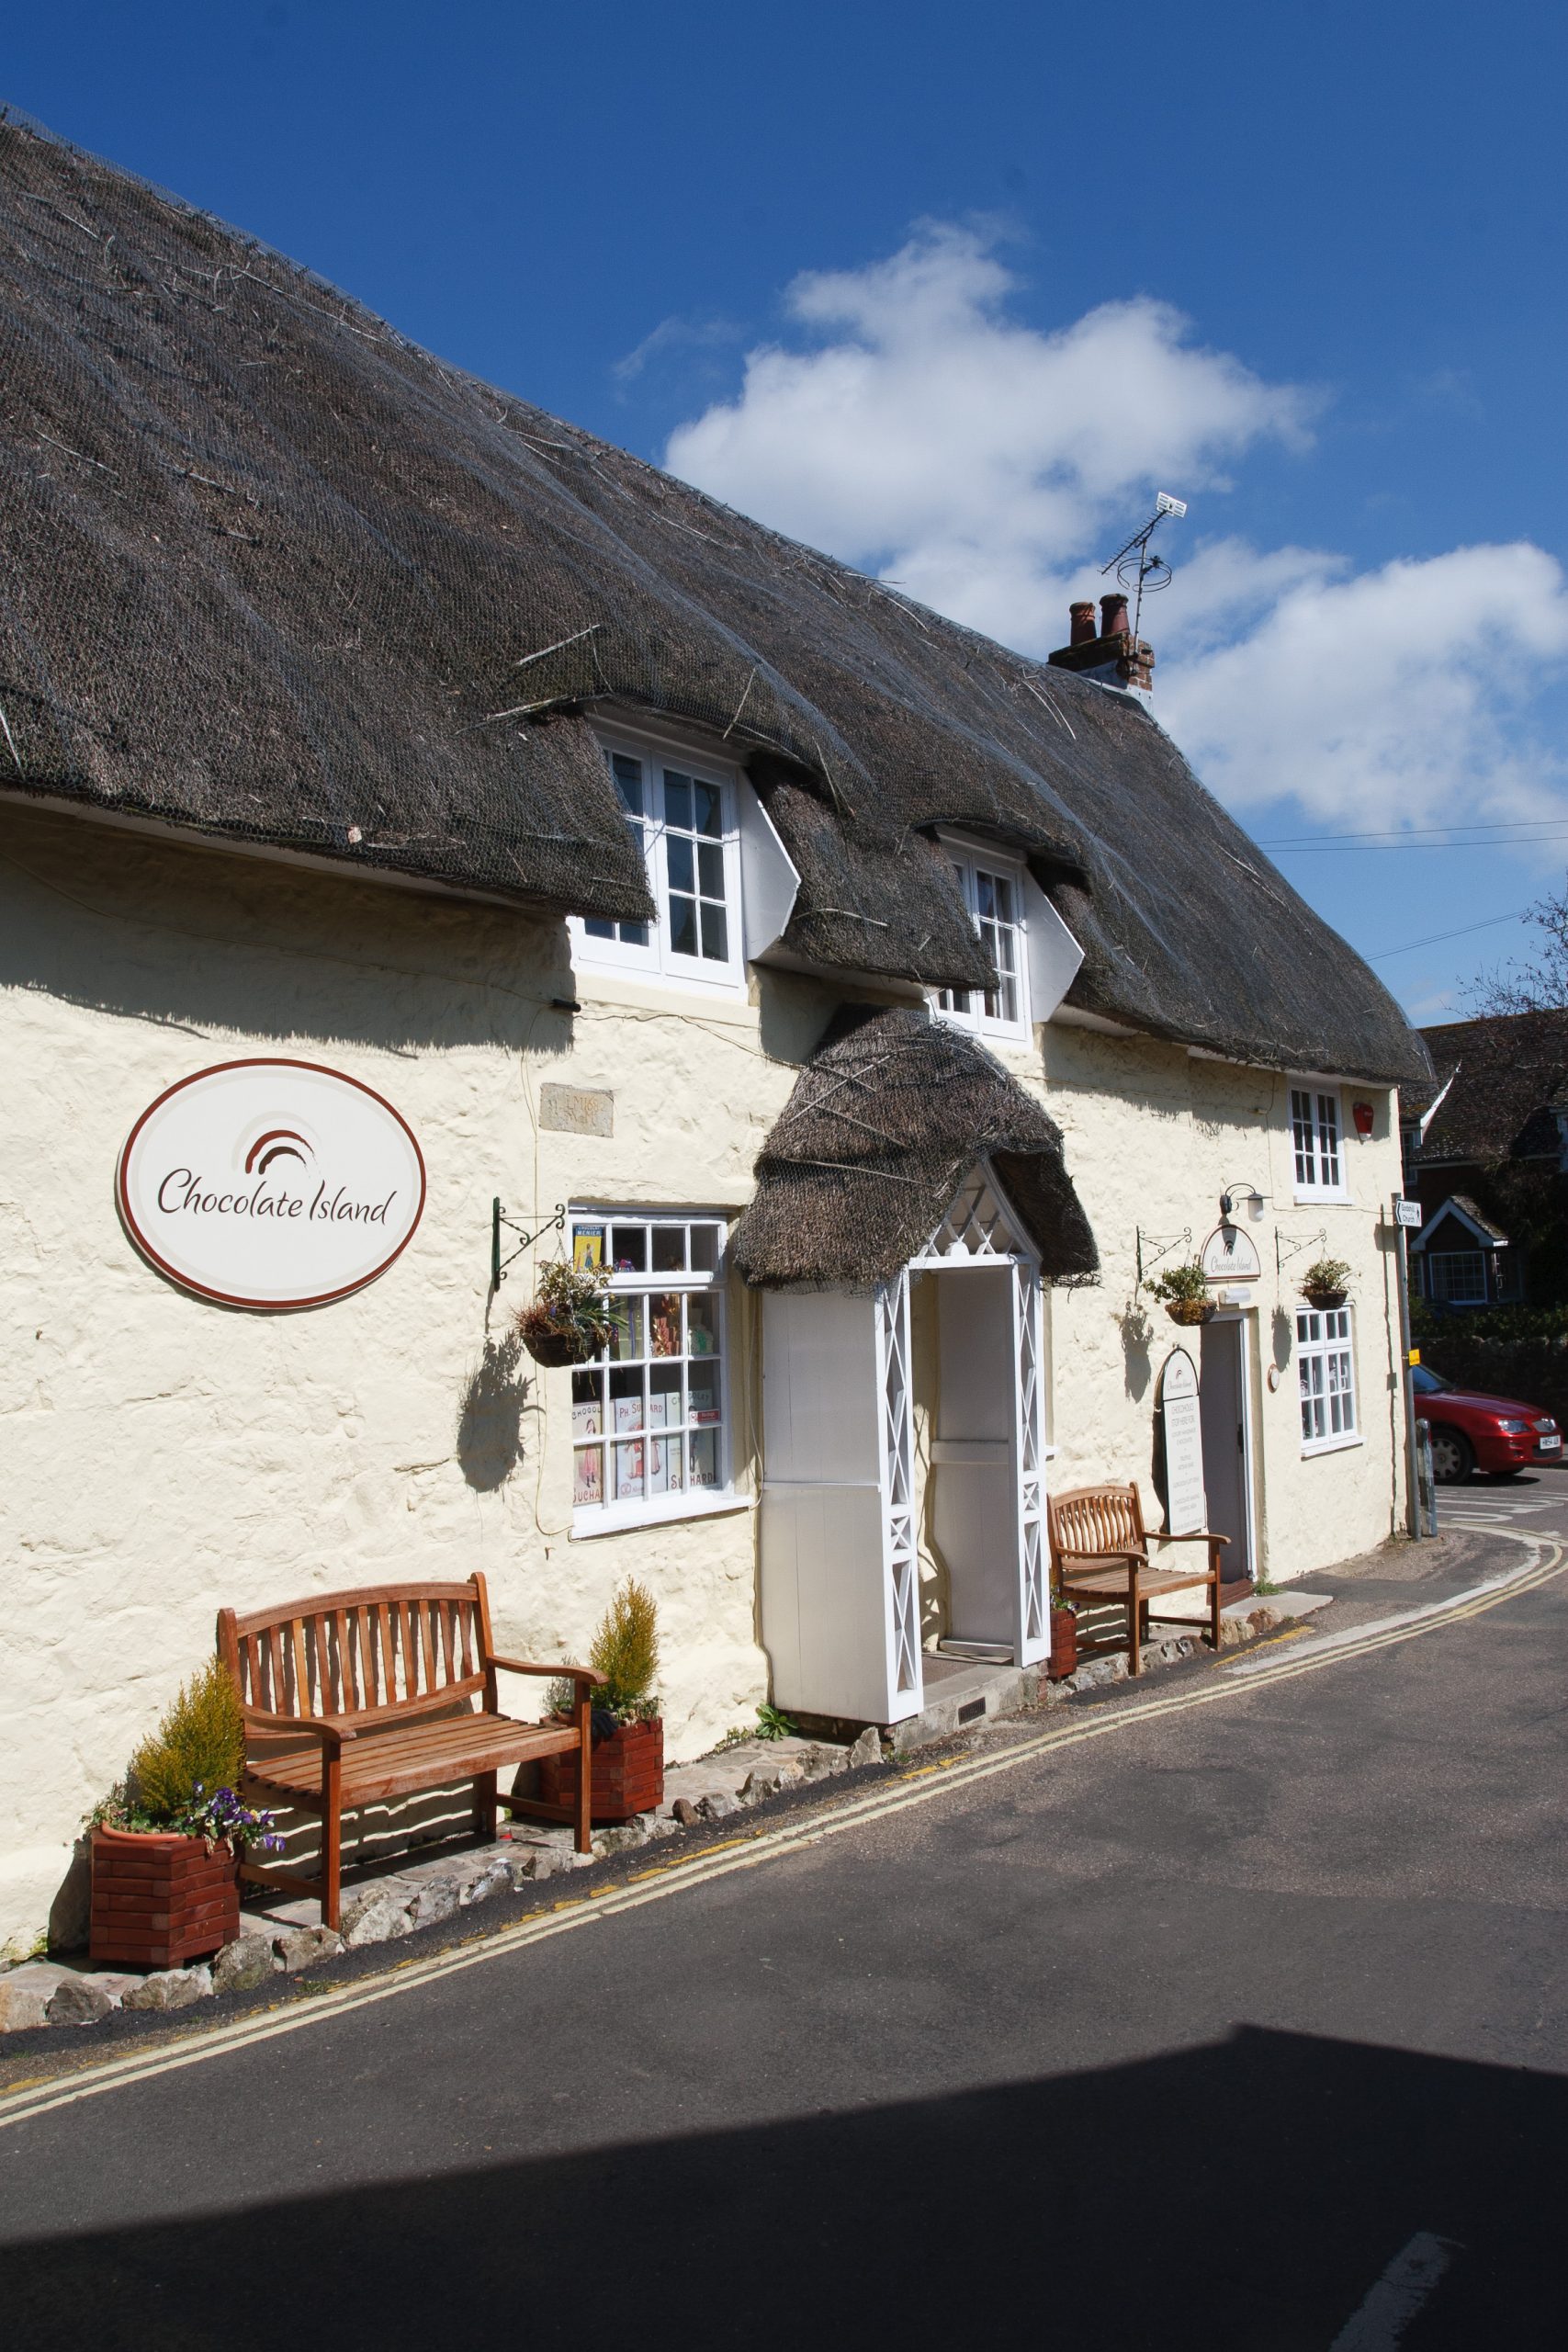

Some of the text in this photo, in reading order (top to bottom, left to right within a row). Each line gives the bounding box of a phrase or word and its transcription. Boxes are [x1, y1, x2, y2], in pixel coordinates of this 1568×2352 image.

[157, 1168, 398, 1225] Chocolate Island
[1211, 1255, 1236, 1272] Chocolate
[632, 1403, 663, 1414] SUARD
[671, 1472, 713, 1489] SUHARD
